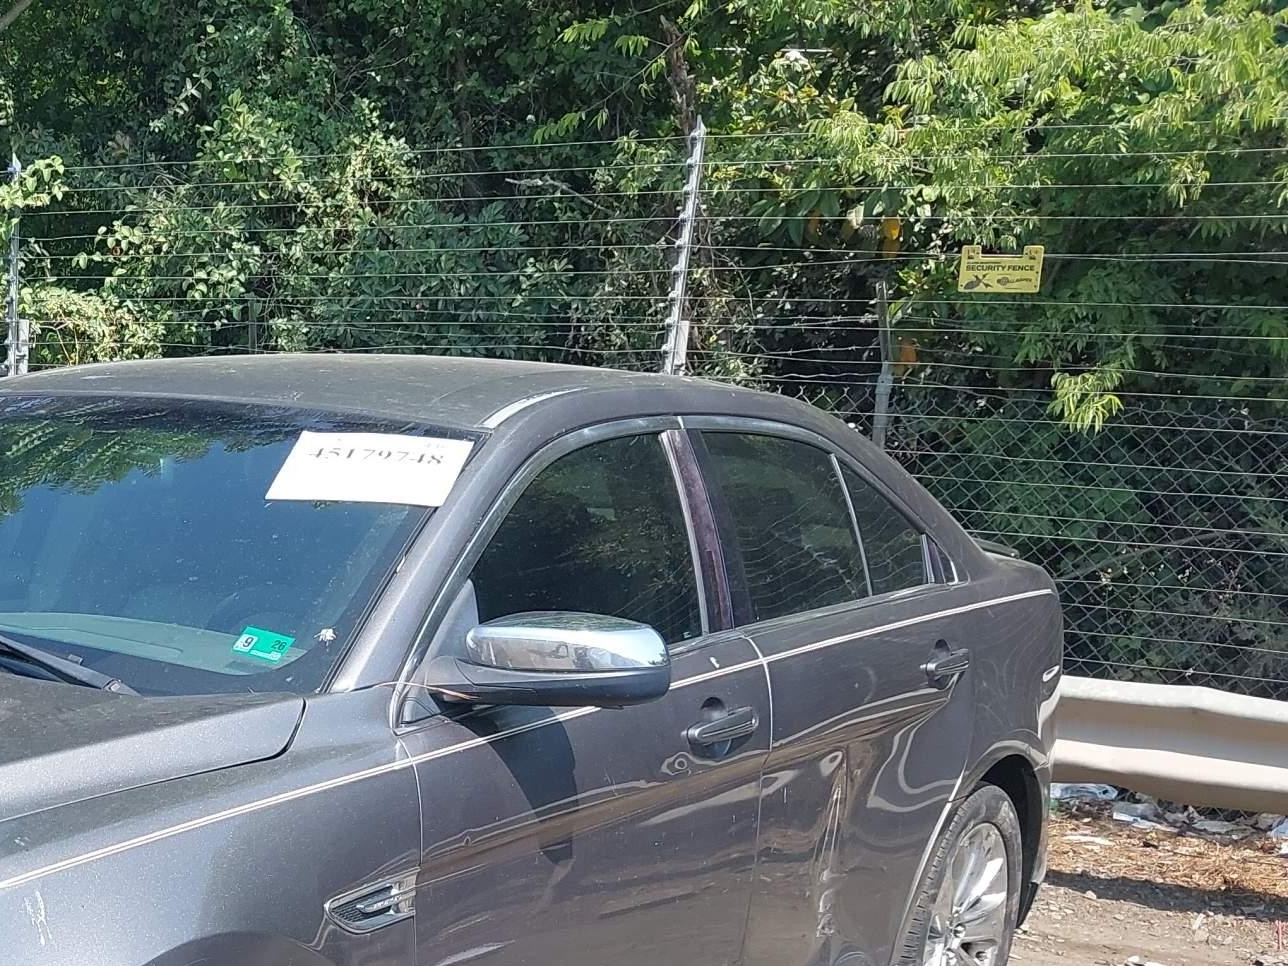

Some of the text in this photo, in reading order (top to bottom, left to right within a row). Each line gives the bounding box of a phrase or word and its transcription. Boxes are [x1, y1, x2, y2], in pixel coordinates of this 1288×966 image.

[965, 264, 1035, 272] SECURITY FENCE
[307, 446, 445, 466] 45179748
[242, 636, 254, 648] 9
[271, 639, 288, 651] 26
